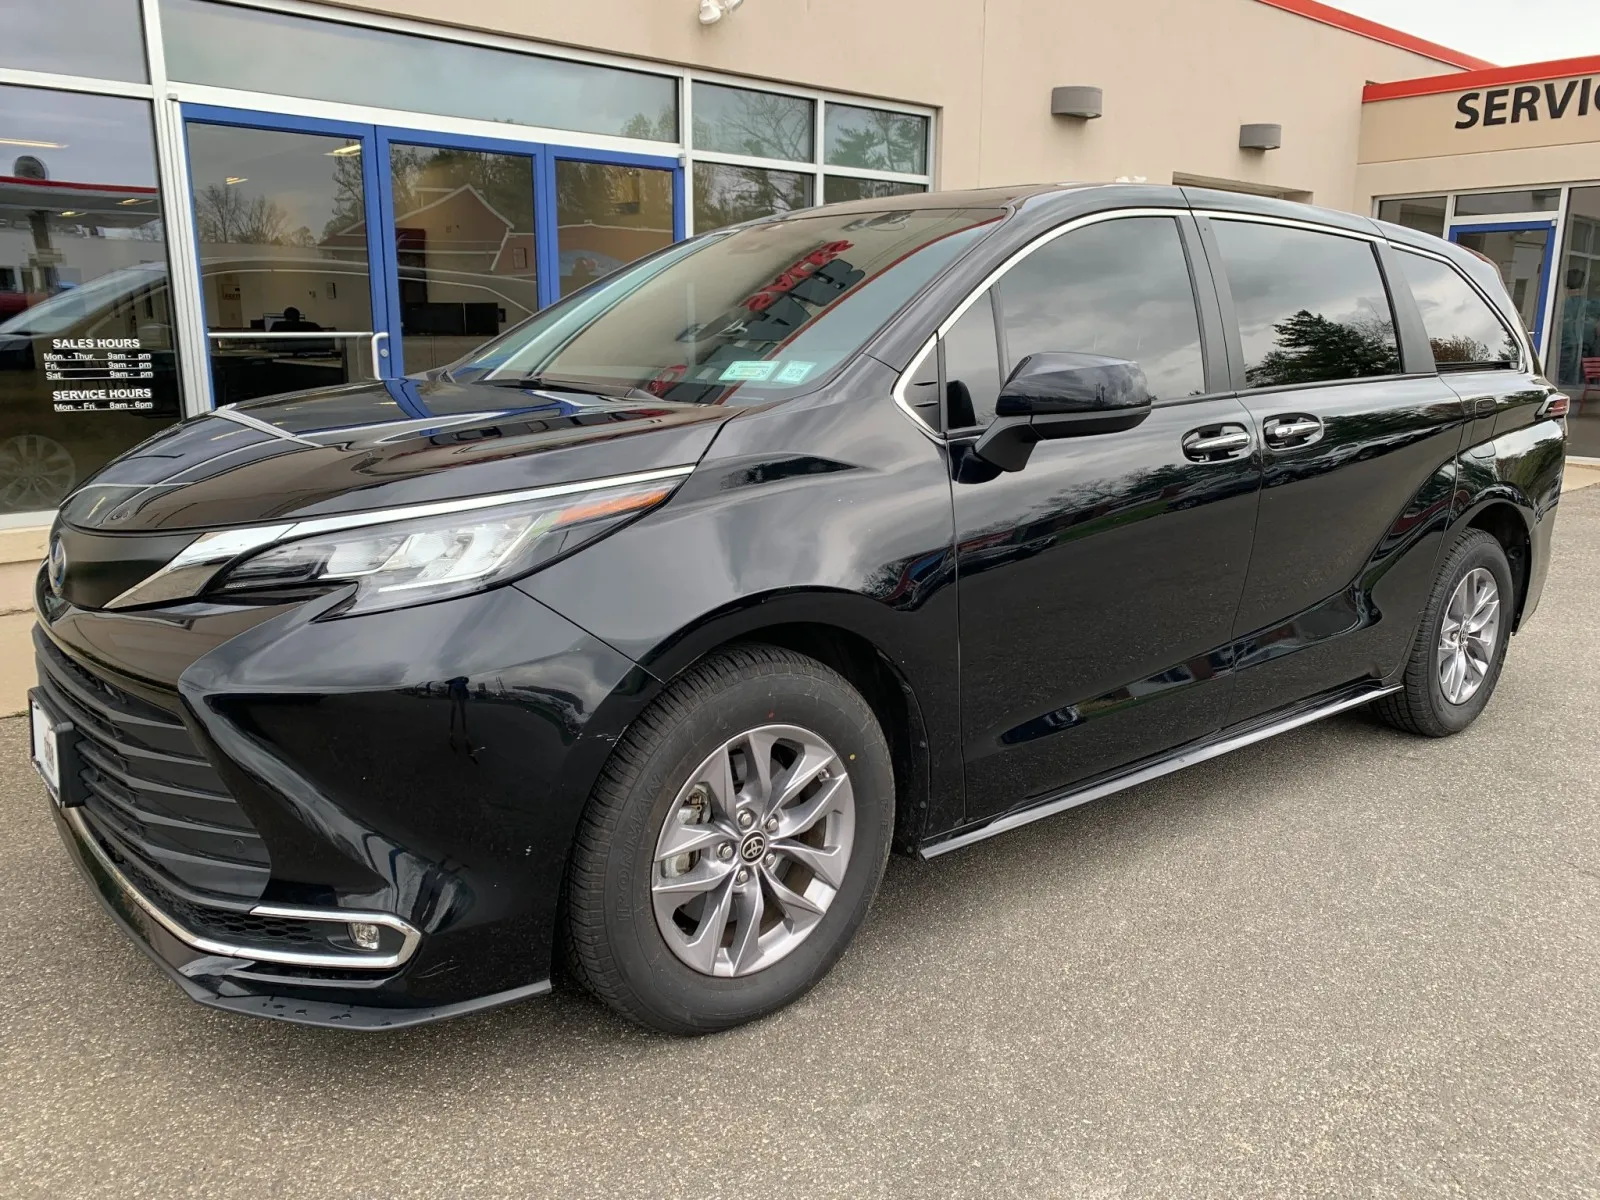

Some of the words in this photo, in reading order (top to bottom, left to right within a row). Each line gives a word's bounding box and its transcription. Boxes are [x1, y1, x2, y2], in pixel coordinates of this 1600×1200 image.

[1454, 77, 1600, 130] SERVI
[52, 338, 95, 349] SALES
[96, 338, 140, 349] HOURS
[43, 352, 66, 361] Mon.
[72, 352, 96, 361] Thur.
[107, 352, 126, 360] 9am
[44, 361, 60, 370] Fri.
[108, 361, 127, 369] 9am
[46, 371, 64, 380] Sat.
[109, 370, 129, 378] 9am
[140, 371, 153, 379] pm
[52, 390, 107, 401] SERVICE
[109, 388, 152, 399] HOURS
[53, 403, 76, 412] Mon.
[83, 402, 98, 410] Fri.
[109, 401, 128, 409] 8am
[134, 400, 153, 409] 6pm
